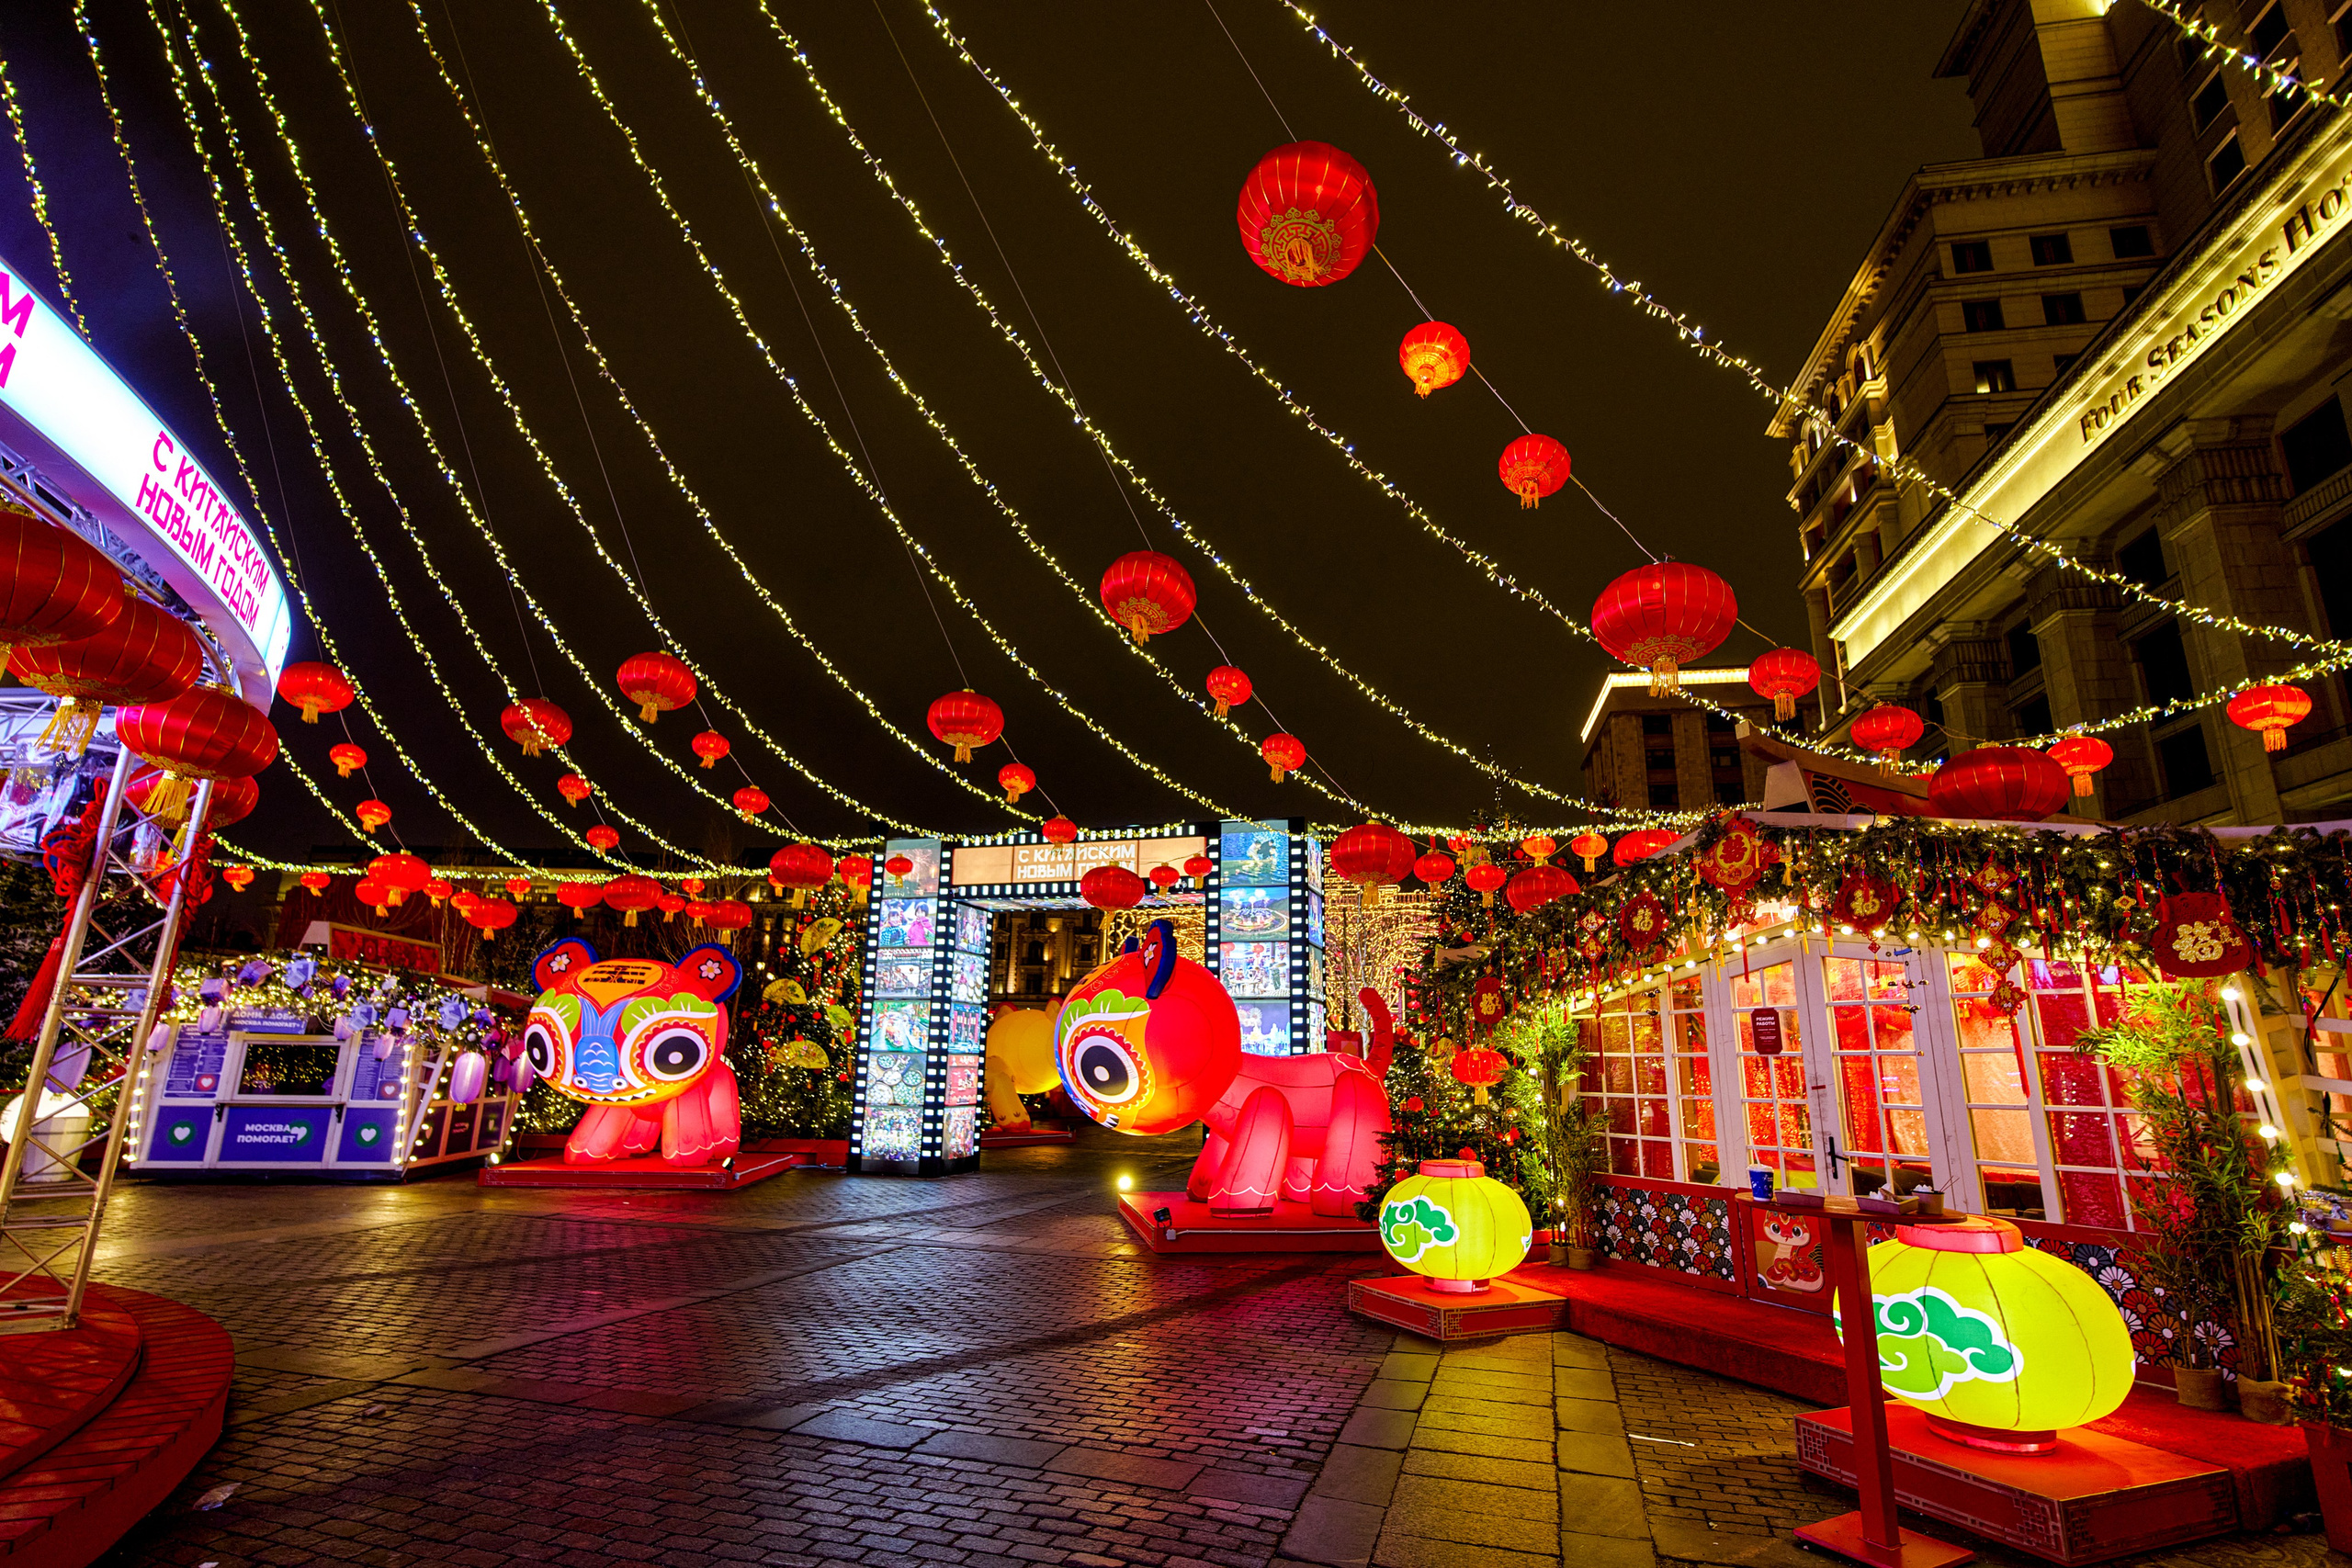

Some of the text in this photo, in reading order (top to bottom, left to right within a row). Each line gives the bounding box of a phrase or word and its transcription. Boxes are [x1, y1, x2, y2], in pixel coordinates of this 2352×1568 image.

[2147, 246, 2282, 384] SEASONS
[2280, 170, 2352, 261] HO
[153, 430, 270, 597] С КИТАЙСКИМ
[136, 473, 260, 632] НОВЫМ ГОДОМ
[1017, 863, 1073, 879] НОВЫМ
[1018, 850, 1030, 863] С
[2172, 920, 2223, 964] 福
[236, 1134, 296, 1144] ПОМОГАЕТ
[244, 1123, 291, 1132] МОСКВА
